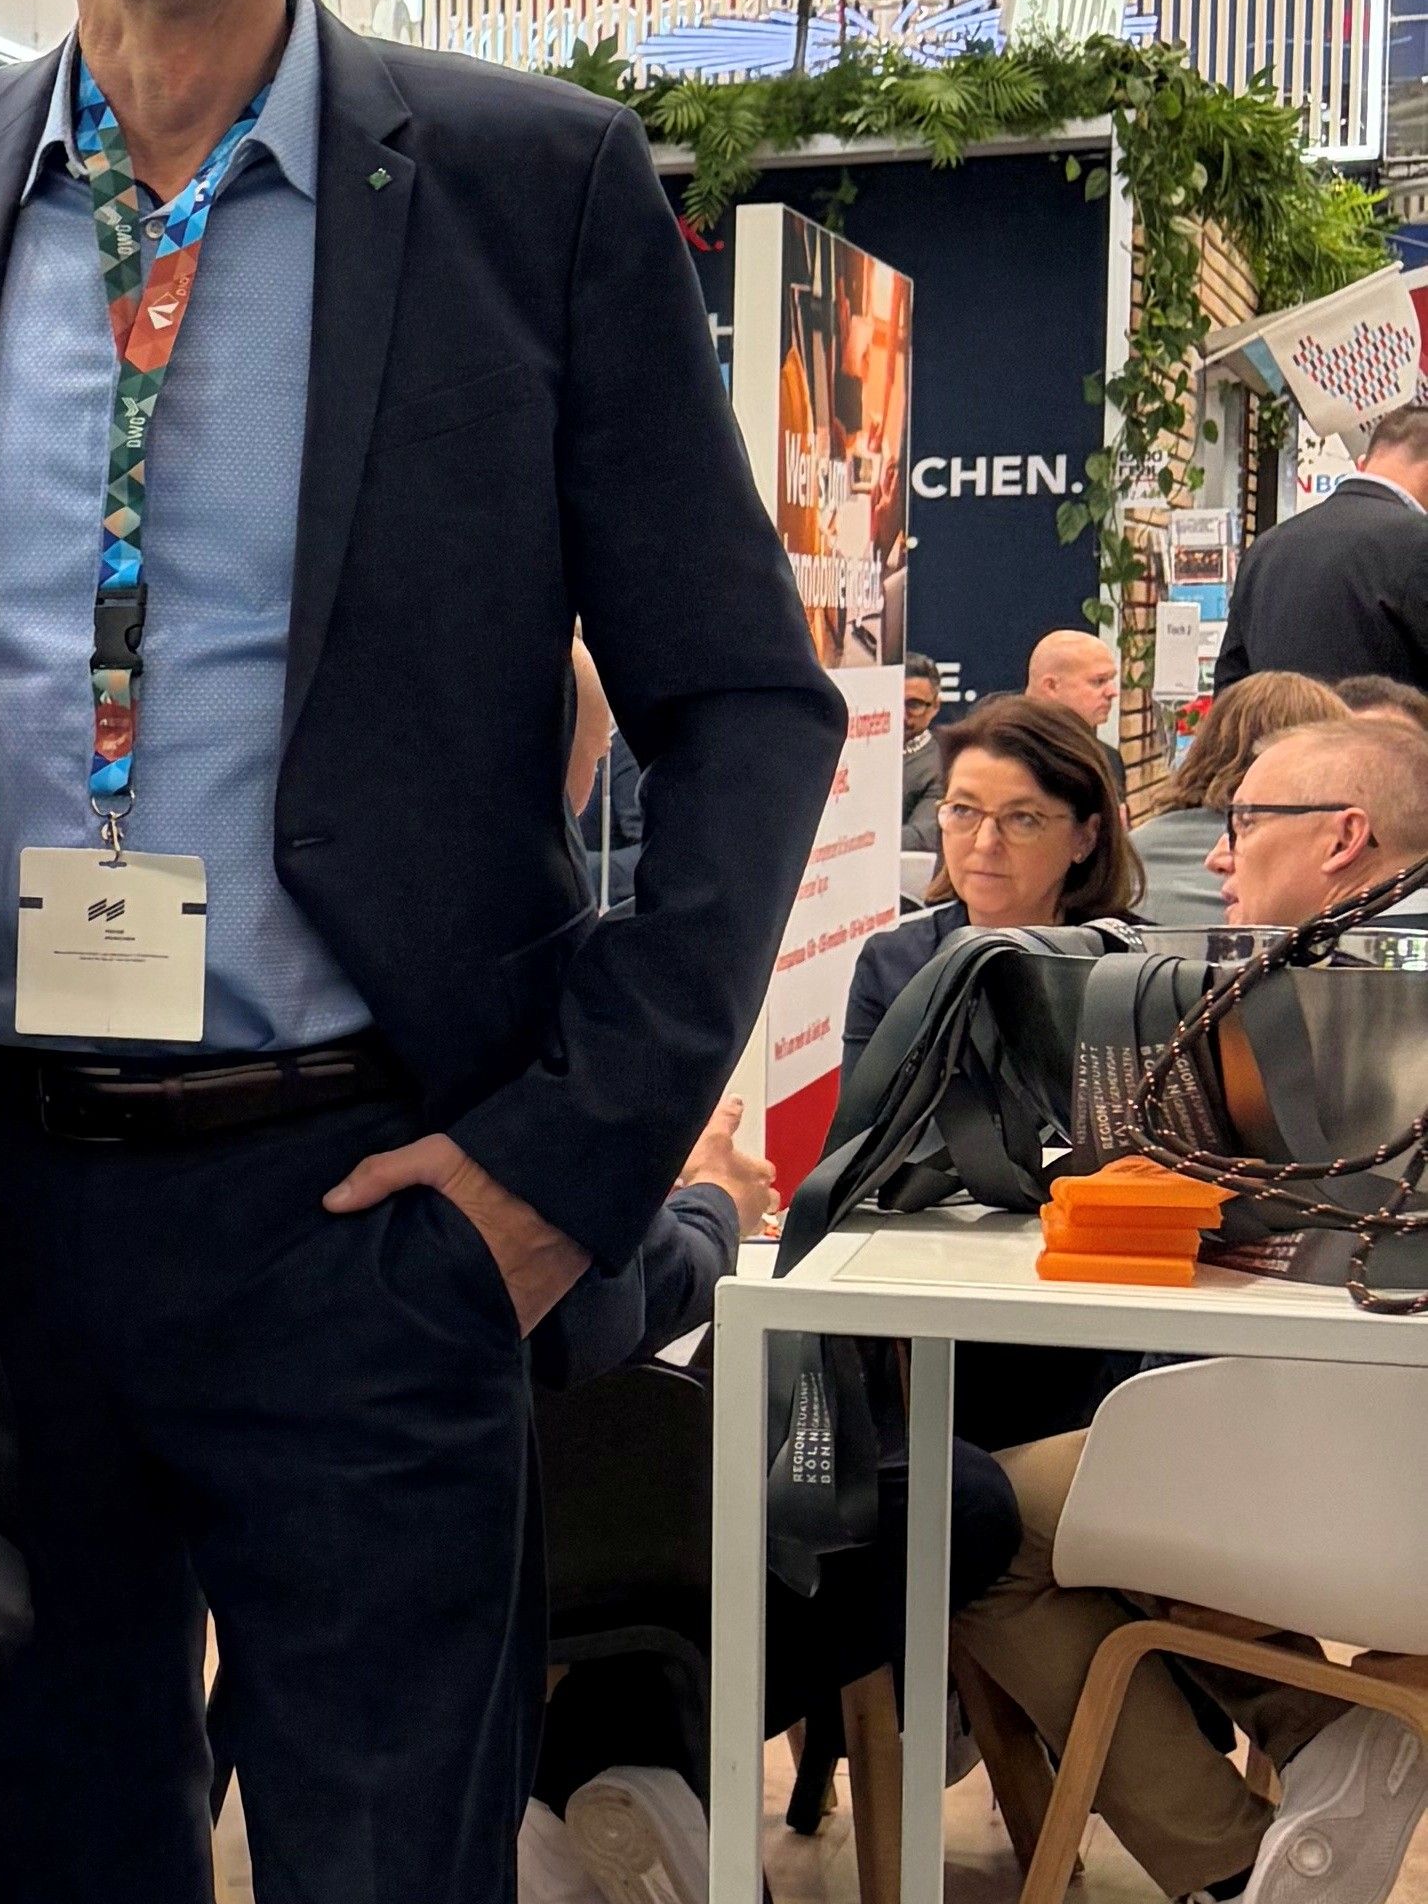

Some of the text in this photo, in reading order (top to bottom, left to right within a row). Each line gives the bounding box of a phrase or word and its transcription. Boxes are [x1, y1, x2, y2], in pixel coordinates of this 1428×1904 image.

[911, 454, 1084, 499] CHEN.
[793, 1430, 806, 1484] REGION
[806, 1432, 820, 1484] KÖLN
[820, 1432, 832, 1484] BONN
